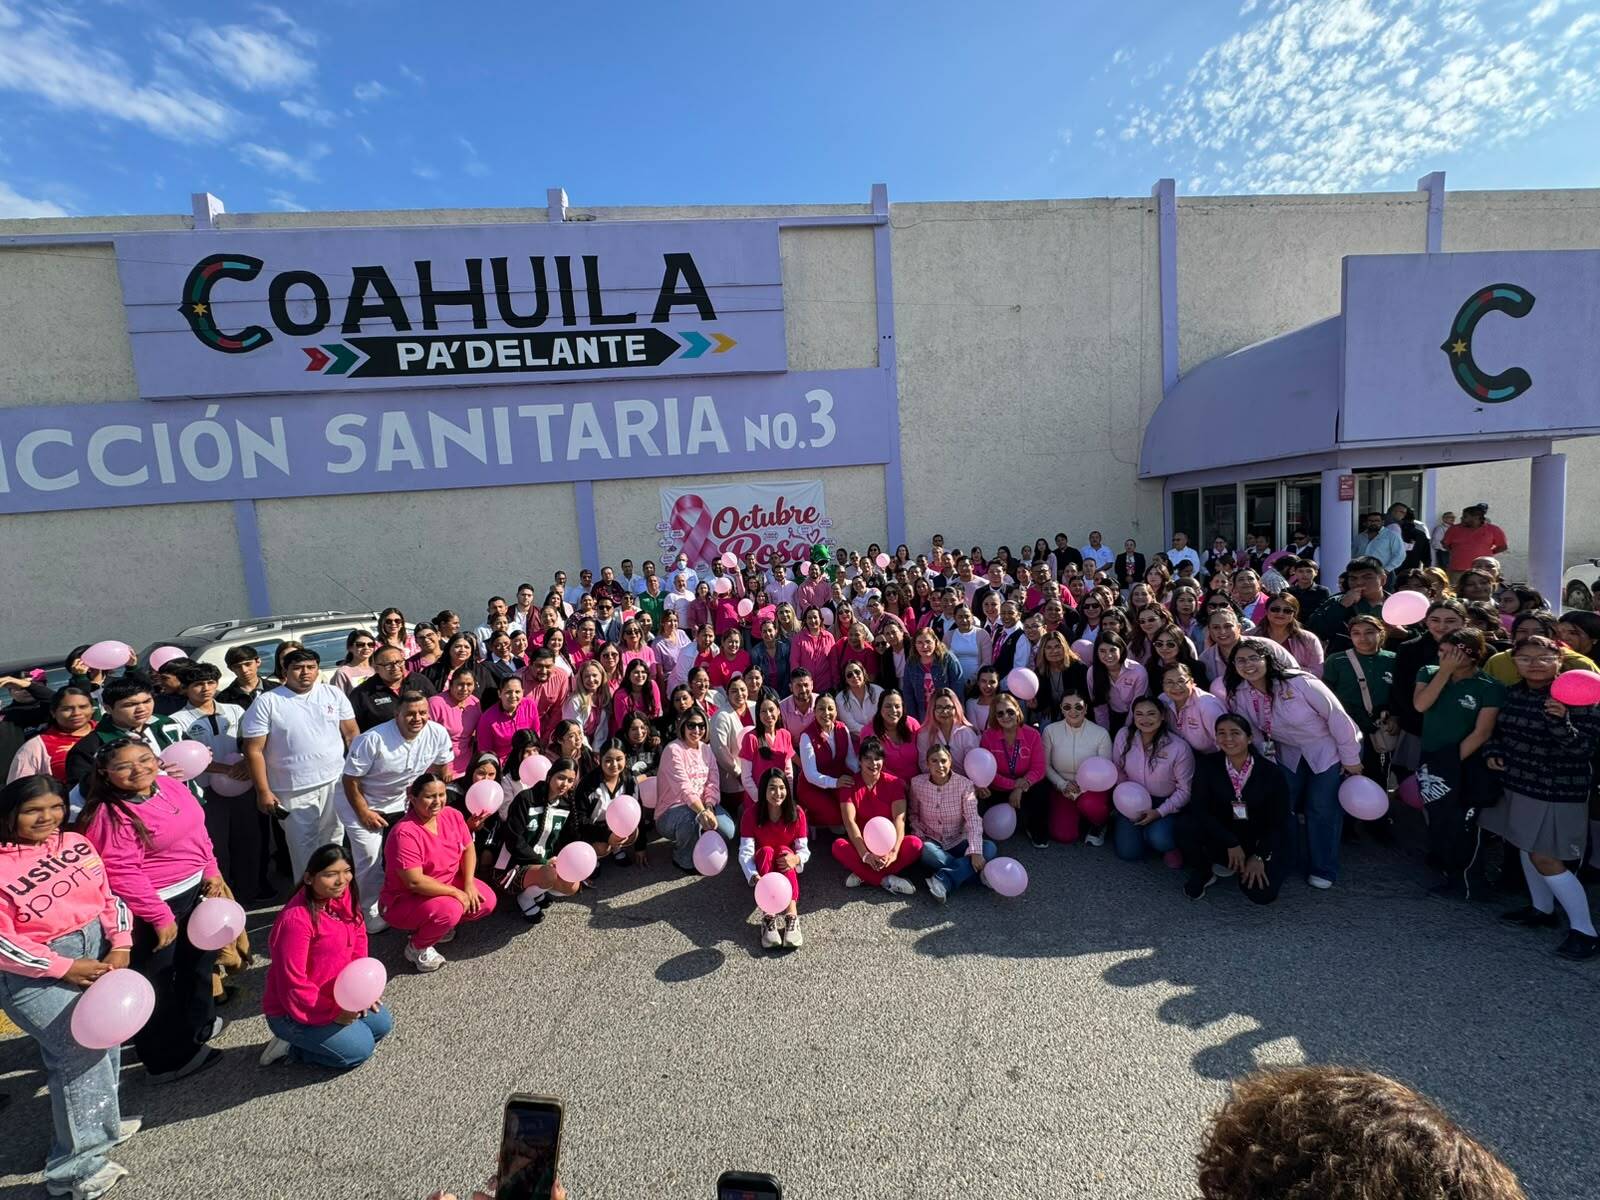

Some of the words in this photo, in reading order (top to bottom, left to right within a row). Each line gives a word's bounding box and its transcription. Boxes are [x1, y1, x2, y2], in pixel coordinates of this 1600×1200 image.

[177, 252, 718, 354] COAHUILA
[0, 404, 291, 493] CCIÓN
[325, 396, 731, 474] SANITARIA
[711, 495, 820, 539] Octubre
[718, 532, 813, 570] Rosa
[6, 841, 92, 896] ustice
